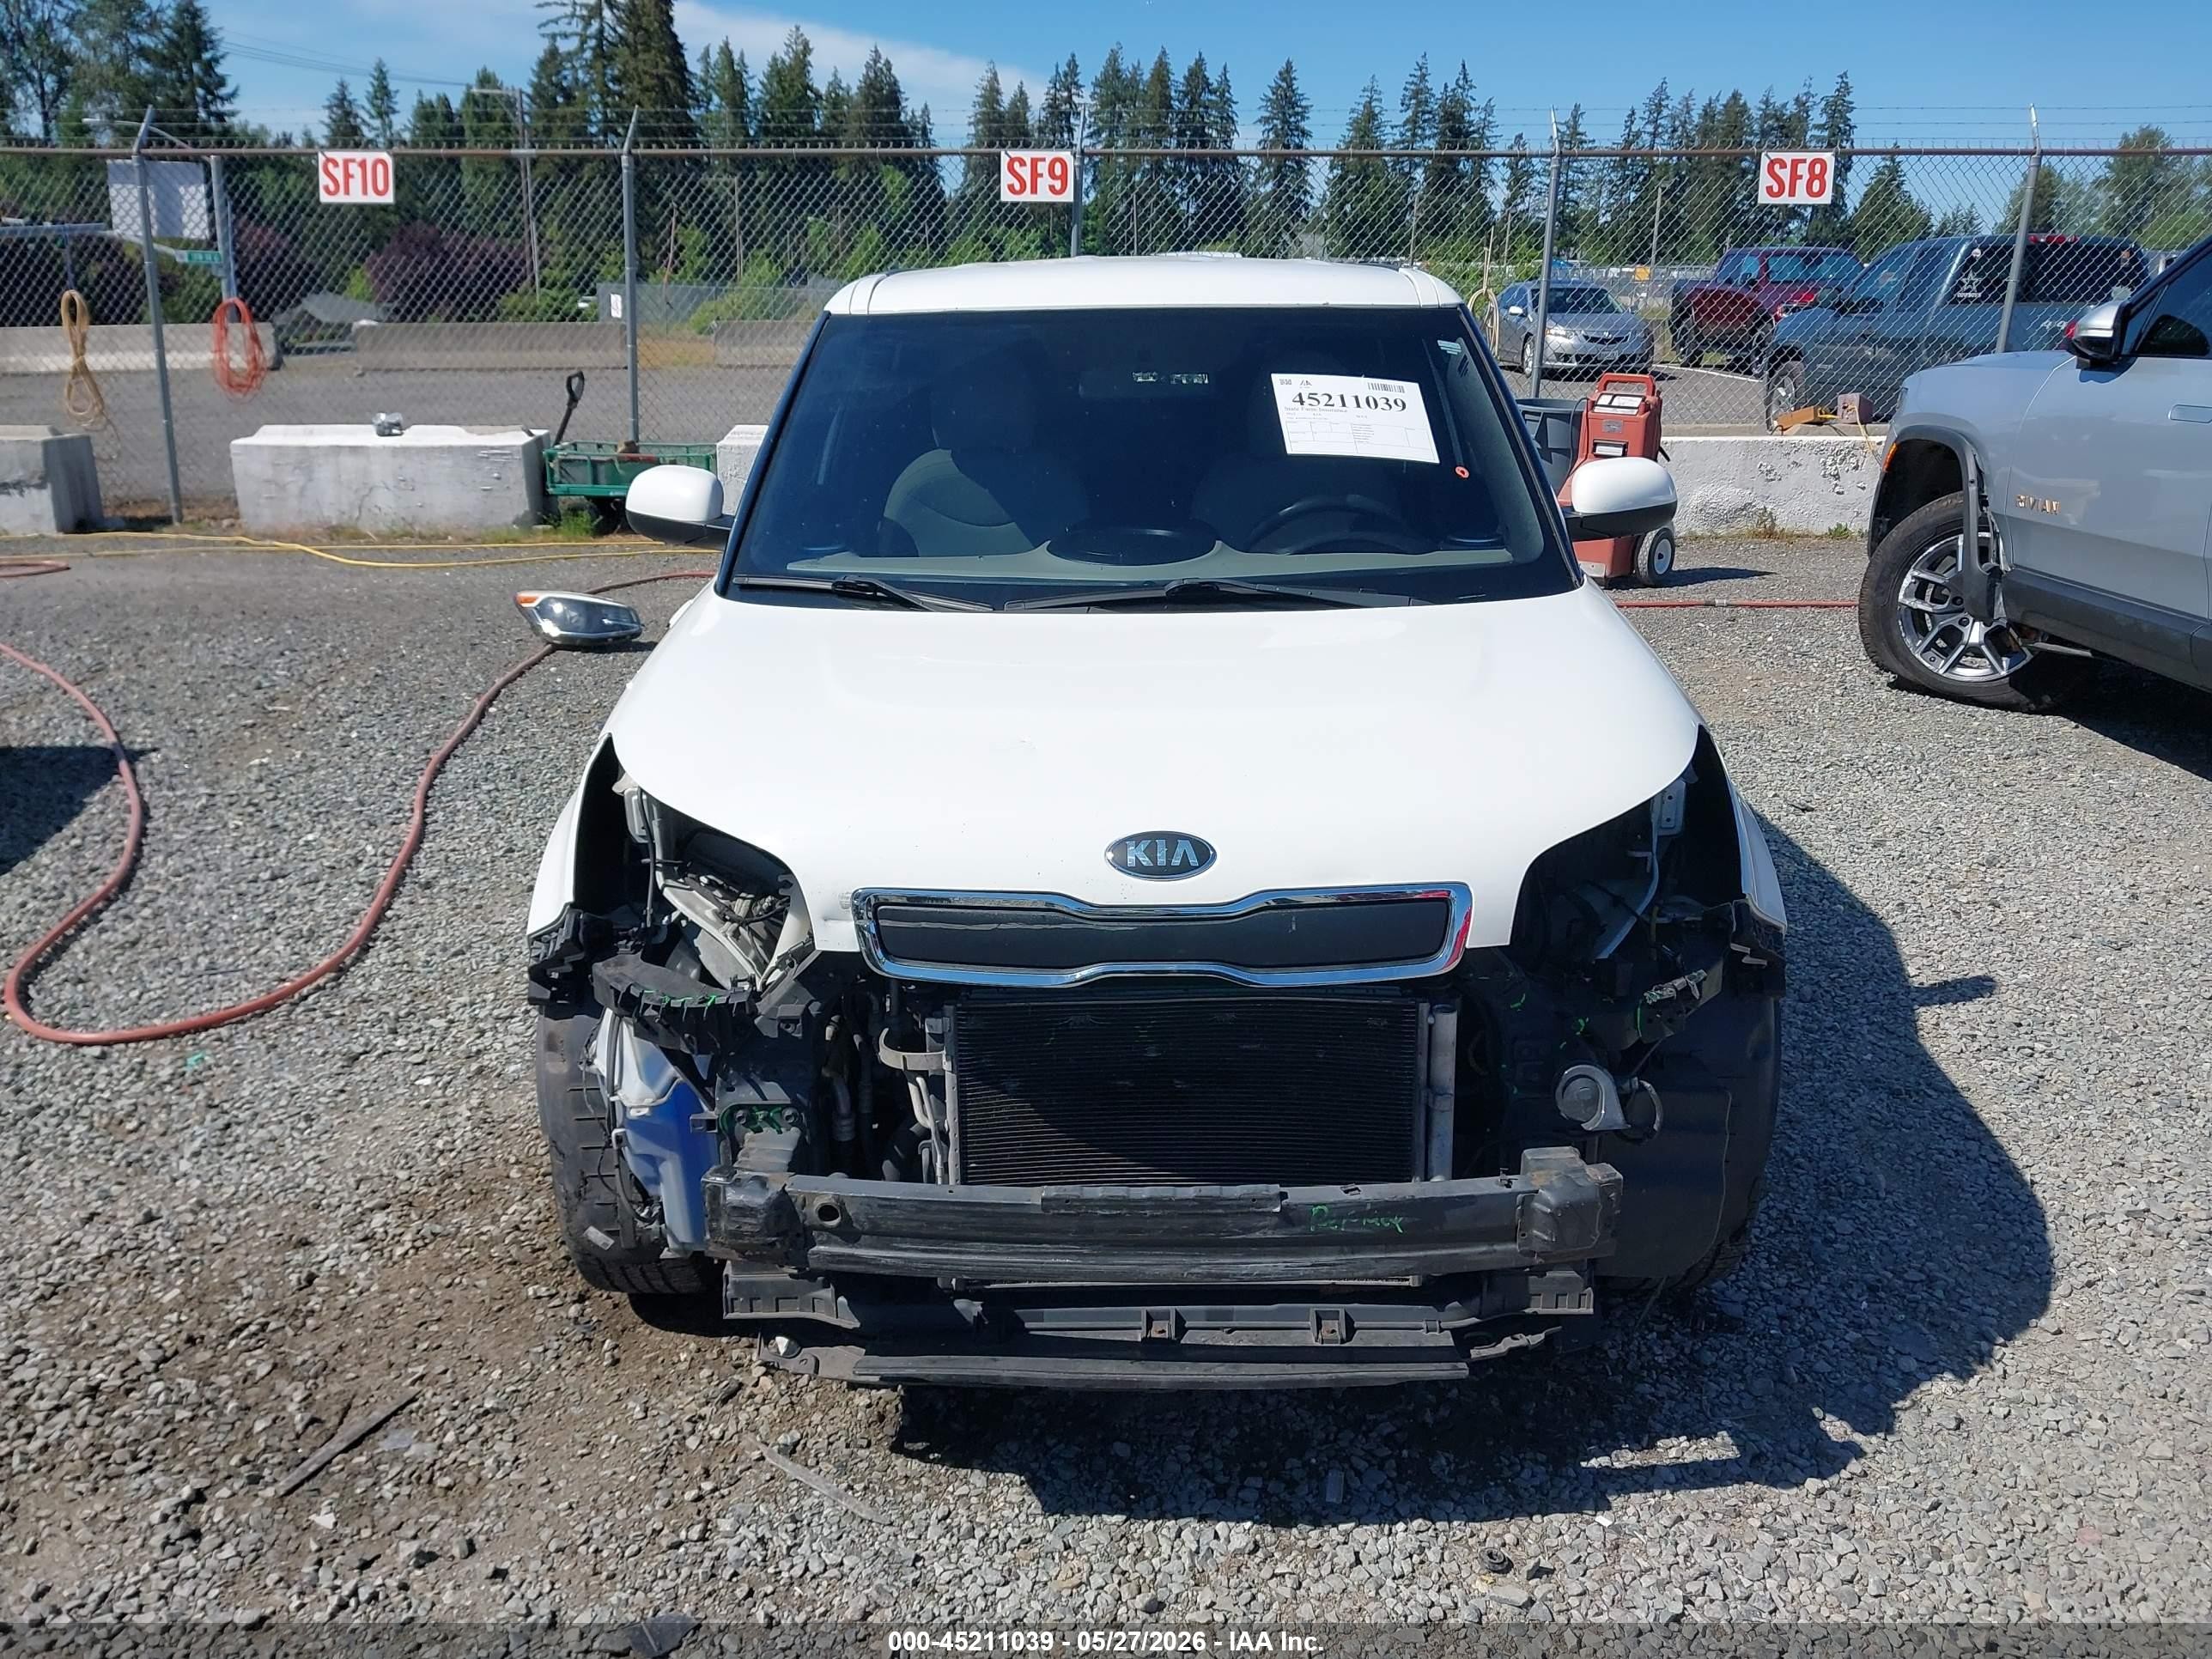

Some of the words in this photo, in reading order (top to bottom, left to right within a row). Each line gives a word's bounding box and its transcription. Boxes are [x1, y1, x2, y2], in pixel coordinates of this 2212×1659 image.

[322, 158, 389, 197] SF10
[1006, 156, 1068, 196] SF9
[1765, 158, 1827, 198] SF8
[1292, 392, 1407, 412] 45211039
[1126, 840, 1199, 867] KIA
